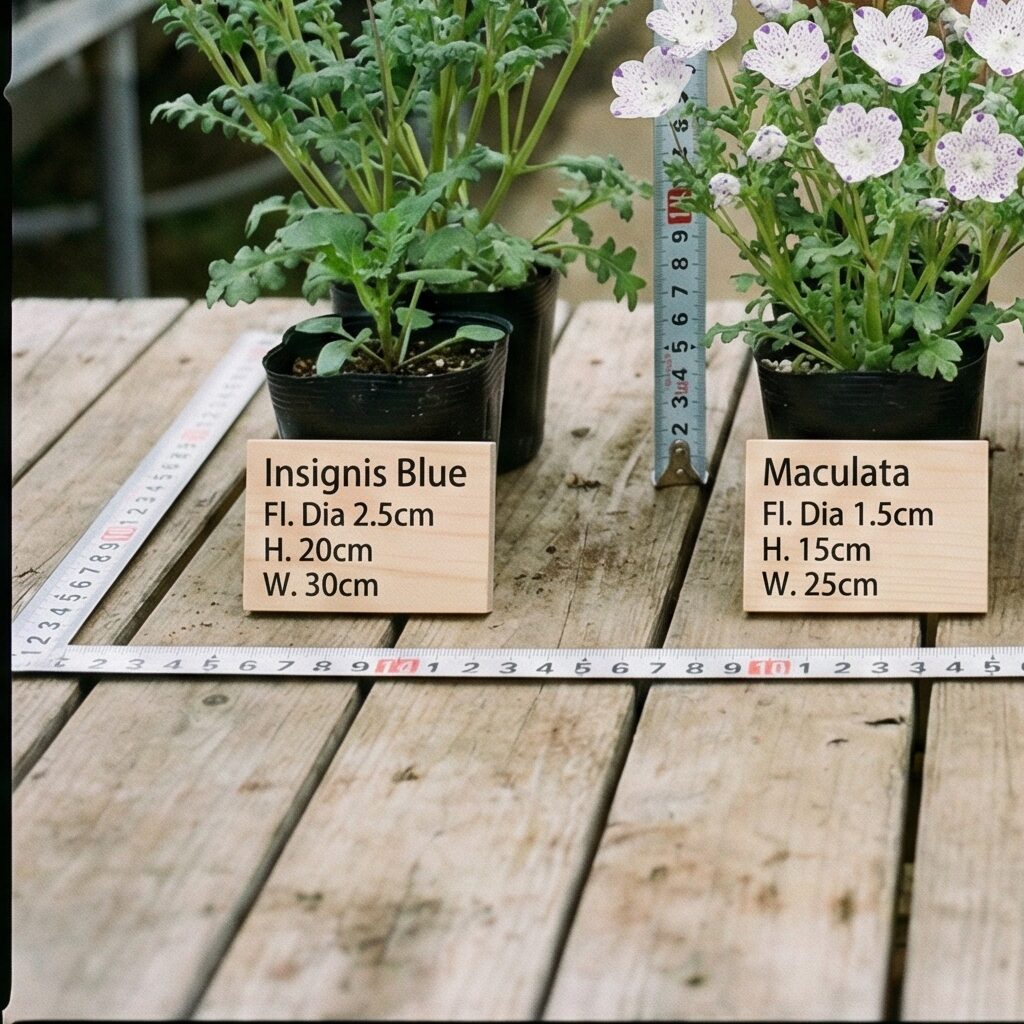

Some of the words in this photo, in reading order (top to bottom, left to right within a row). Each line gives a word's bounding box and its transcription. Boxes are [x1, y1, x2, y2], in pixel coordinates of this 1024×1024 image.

[671, 257, 690, 271] 8
[671, 285, 690, 298] 7
[671, 312, 690, 327] 6
[671, 340, 690, 353] 5
[671, 367, 690, 382] 4
[671, 395, 690, 409] 3
[671, 422, 690, 436] 2
[266, 457, 387, 494] Insignis
[397, 456, 467, 487] Blue
[763, 455, 910, 487] Maculata
[264, 500, 294, 527] Fl.
[302, 501, 345, 527] Dia
[353, 501, 434, 527] 2.5cm
[763, 500, 792, 526] Fl.
[801, 501, 844, 527] Dia
[854, 501, 934, 527] 1.5cm
[98, 542, 120, 550] 9
[264, 537, 291, 562] H.
[298, 537, 373, 562] 20cm
[763, 536, 790, 562] H.
[799, 537, 871, 562] 15cm
[89, 554, 111, 562] 8
[69, 580, 92, 589] 6
[262, 571, 297, 597] W.
[305, 572, 378, 597] 30cm
[762, 571, 796, 597] W.
[804, 571, 878, 597] 25cm
[50, 607, 72, 616] 4
[38, 621, 60, 630] 3
[26, 636, 51, 645] 2
[87, 658, 108, 670] 2
[125, 658, 145, 670] 3
[163, 659, 182, 670] 4
[202, 659, 218, 671] 5
[238, 660, 257, 671] 6
[276, 660, 296, 671] 7
[312, 660, 332, 672] 8
[350, 661, 370, 672] 9
[427, 662, 439, 673] 1
[461, 662, 480, 673] 2
[498, 662, 518, 674] 3
[535, 662, 554, 674] 4
[574, 662, 592, 675] 5
[611, 662, 629, 674] 6
[648, 662, 666, 674] 7
[685, 662, 704, 674] 8
[723, 662, 742, 674] 9
[755, 661, 786, 674] 10
[798, 662, 811, 674] 1
[833, 662, 852, 674] 2
[871, 662, 890, 674] 3
[945, 661, 964, 673] 4
[983, 661, 1002, 673] 5
